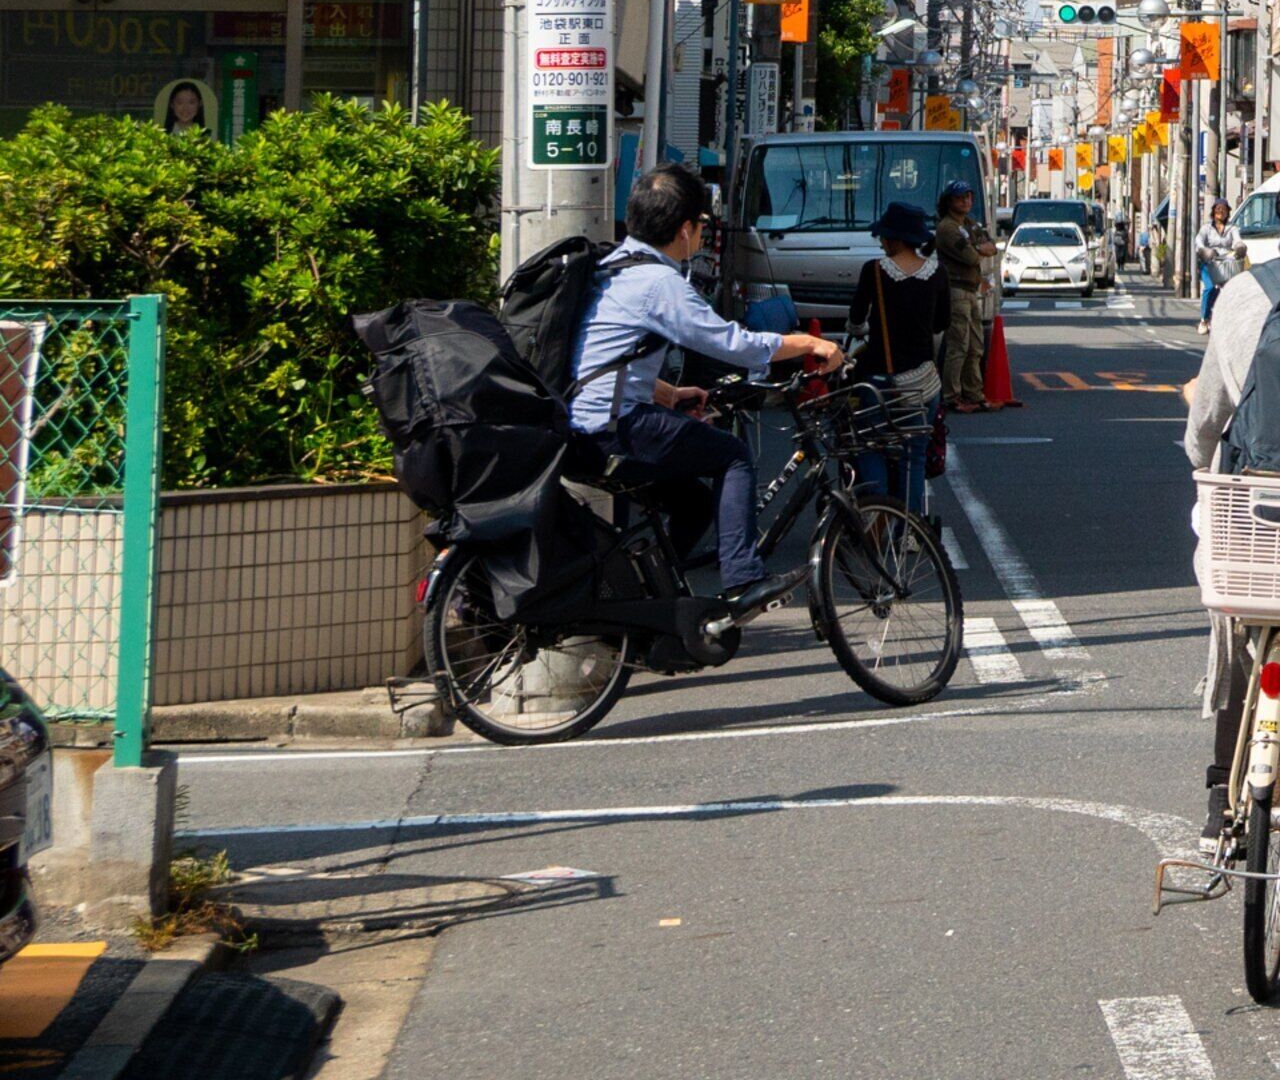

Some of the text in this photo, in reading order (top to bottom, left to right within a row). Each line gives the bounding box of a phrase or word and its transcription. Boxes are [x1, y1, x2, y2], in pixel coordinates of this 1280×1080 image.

[539, 18, 604, 30] 池袋駅東口
[533, 72, 608, 86] 0120-901-921
[545, 119, 598, 135] 南長崎
